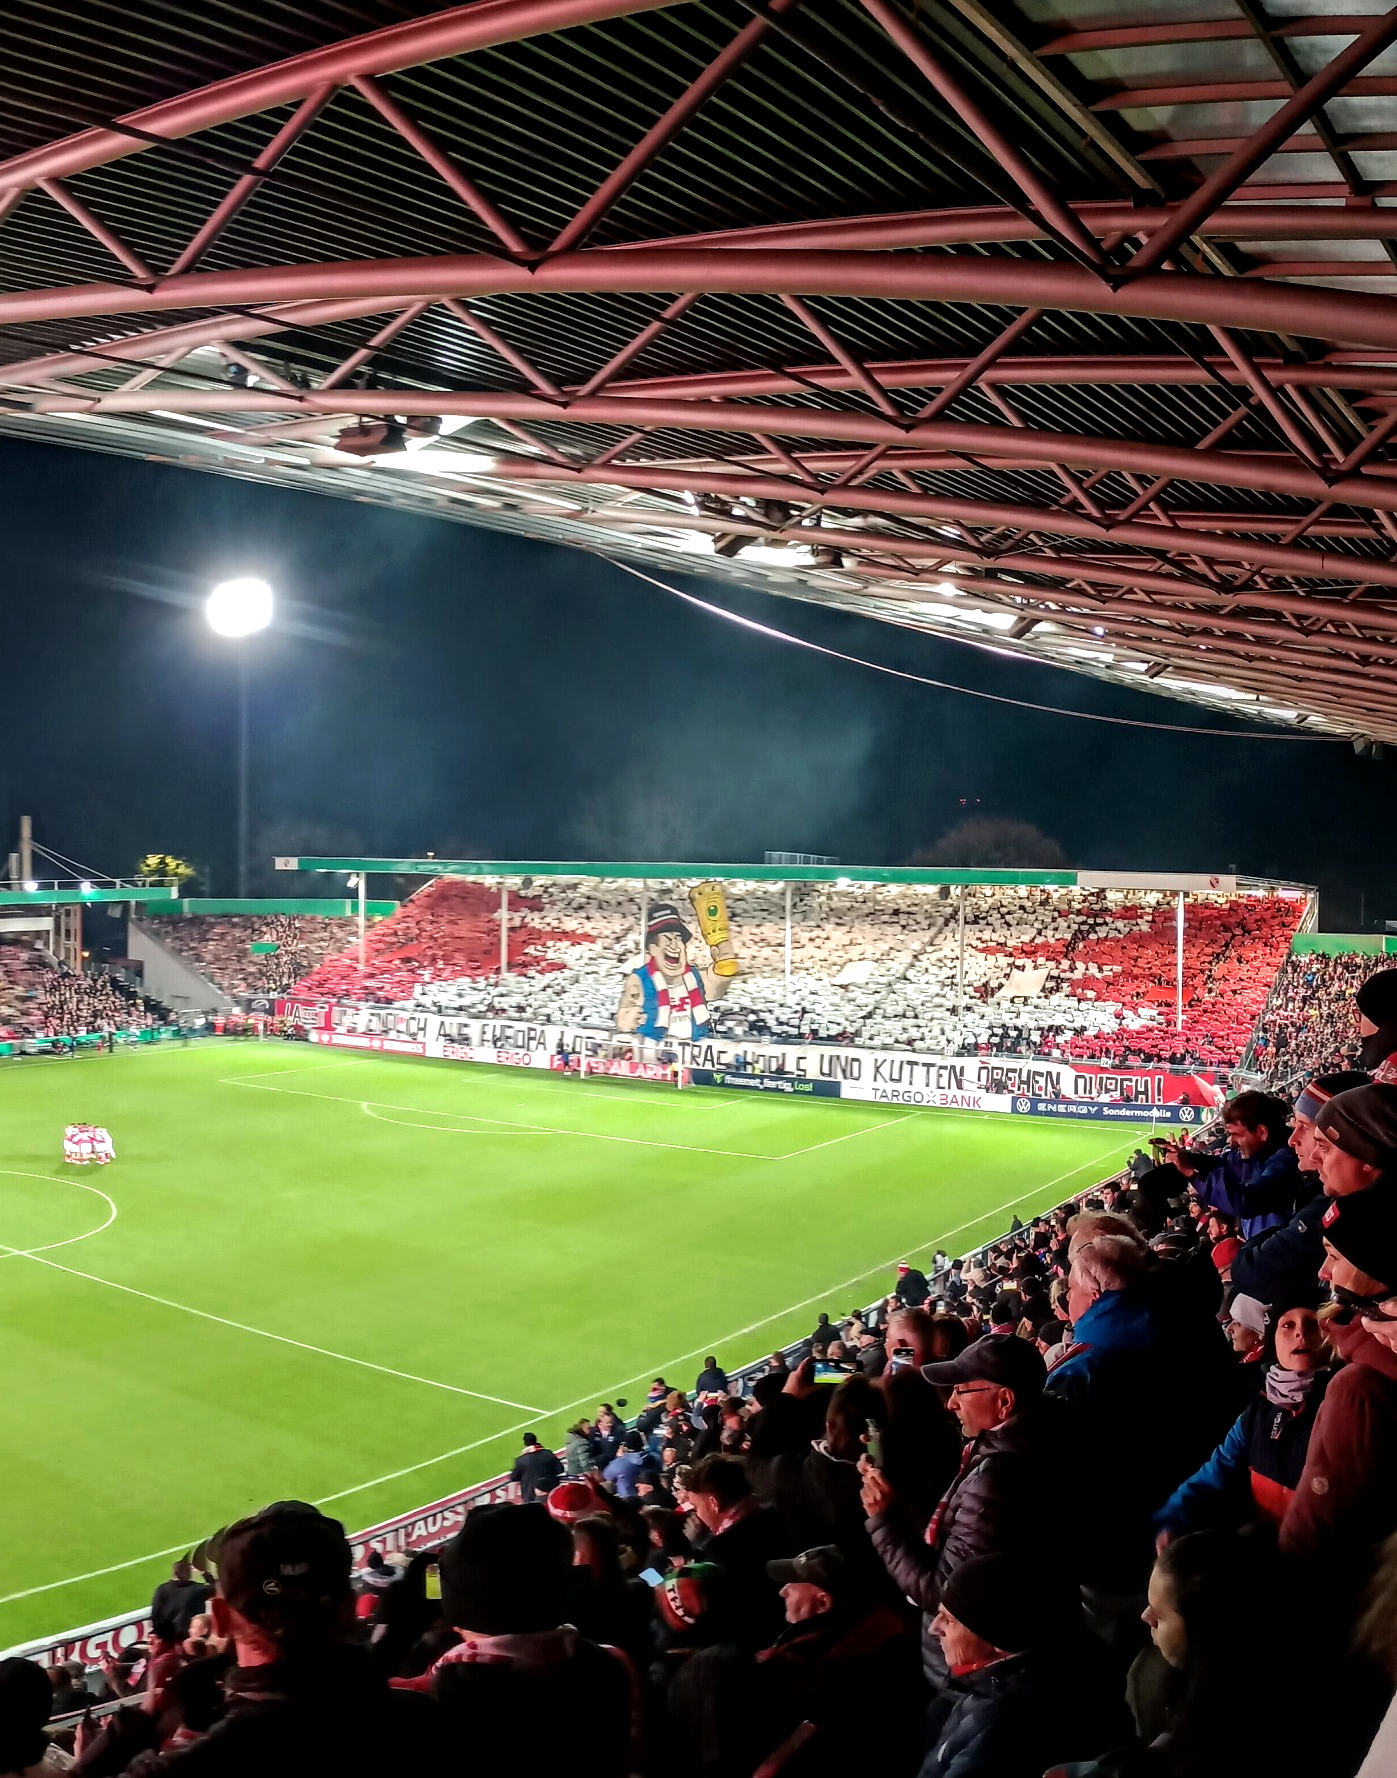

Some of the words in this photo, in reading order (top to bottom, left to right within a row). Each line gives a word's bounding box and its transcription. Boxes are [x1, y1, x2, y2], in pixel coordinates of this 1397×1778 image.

[496, 1050, 532, 1066] ERGO
[1101, 1058, 1110, 1067] 24
[553, 1056, 673, 1081] FLERALARM
[819, 1054, 862, 1081] UND
[873, 1057, 965, 1091] KUTTEN
[977, 1065, 1061, 1098] DREHEN
[1037, 1103, 1098, 1114] ENERGY
[1103, 1107, 1171, 1118] Sondermodelle
